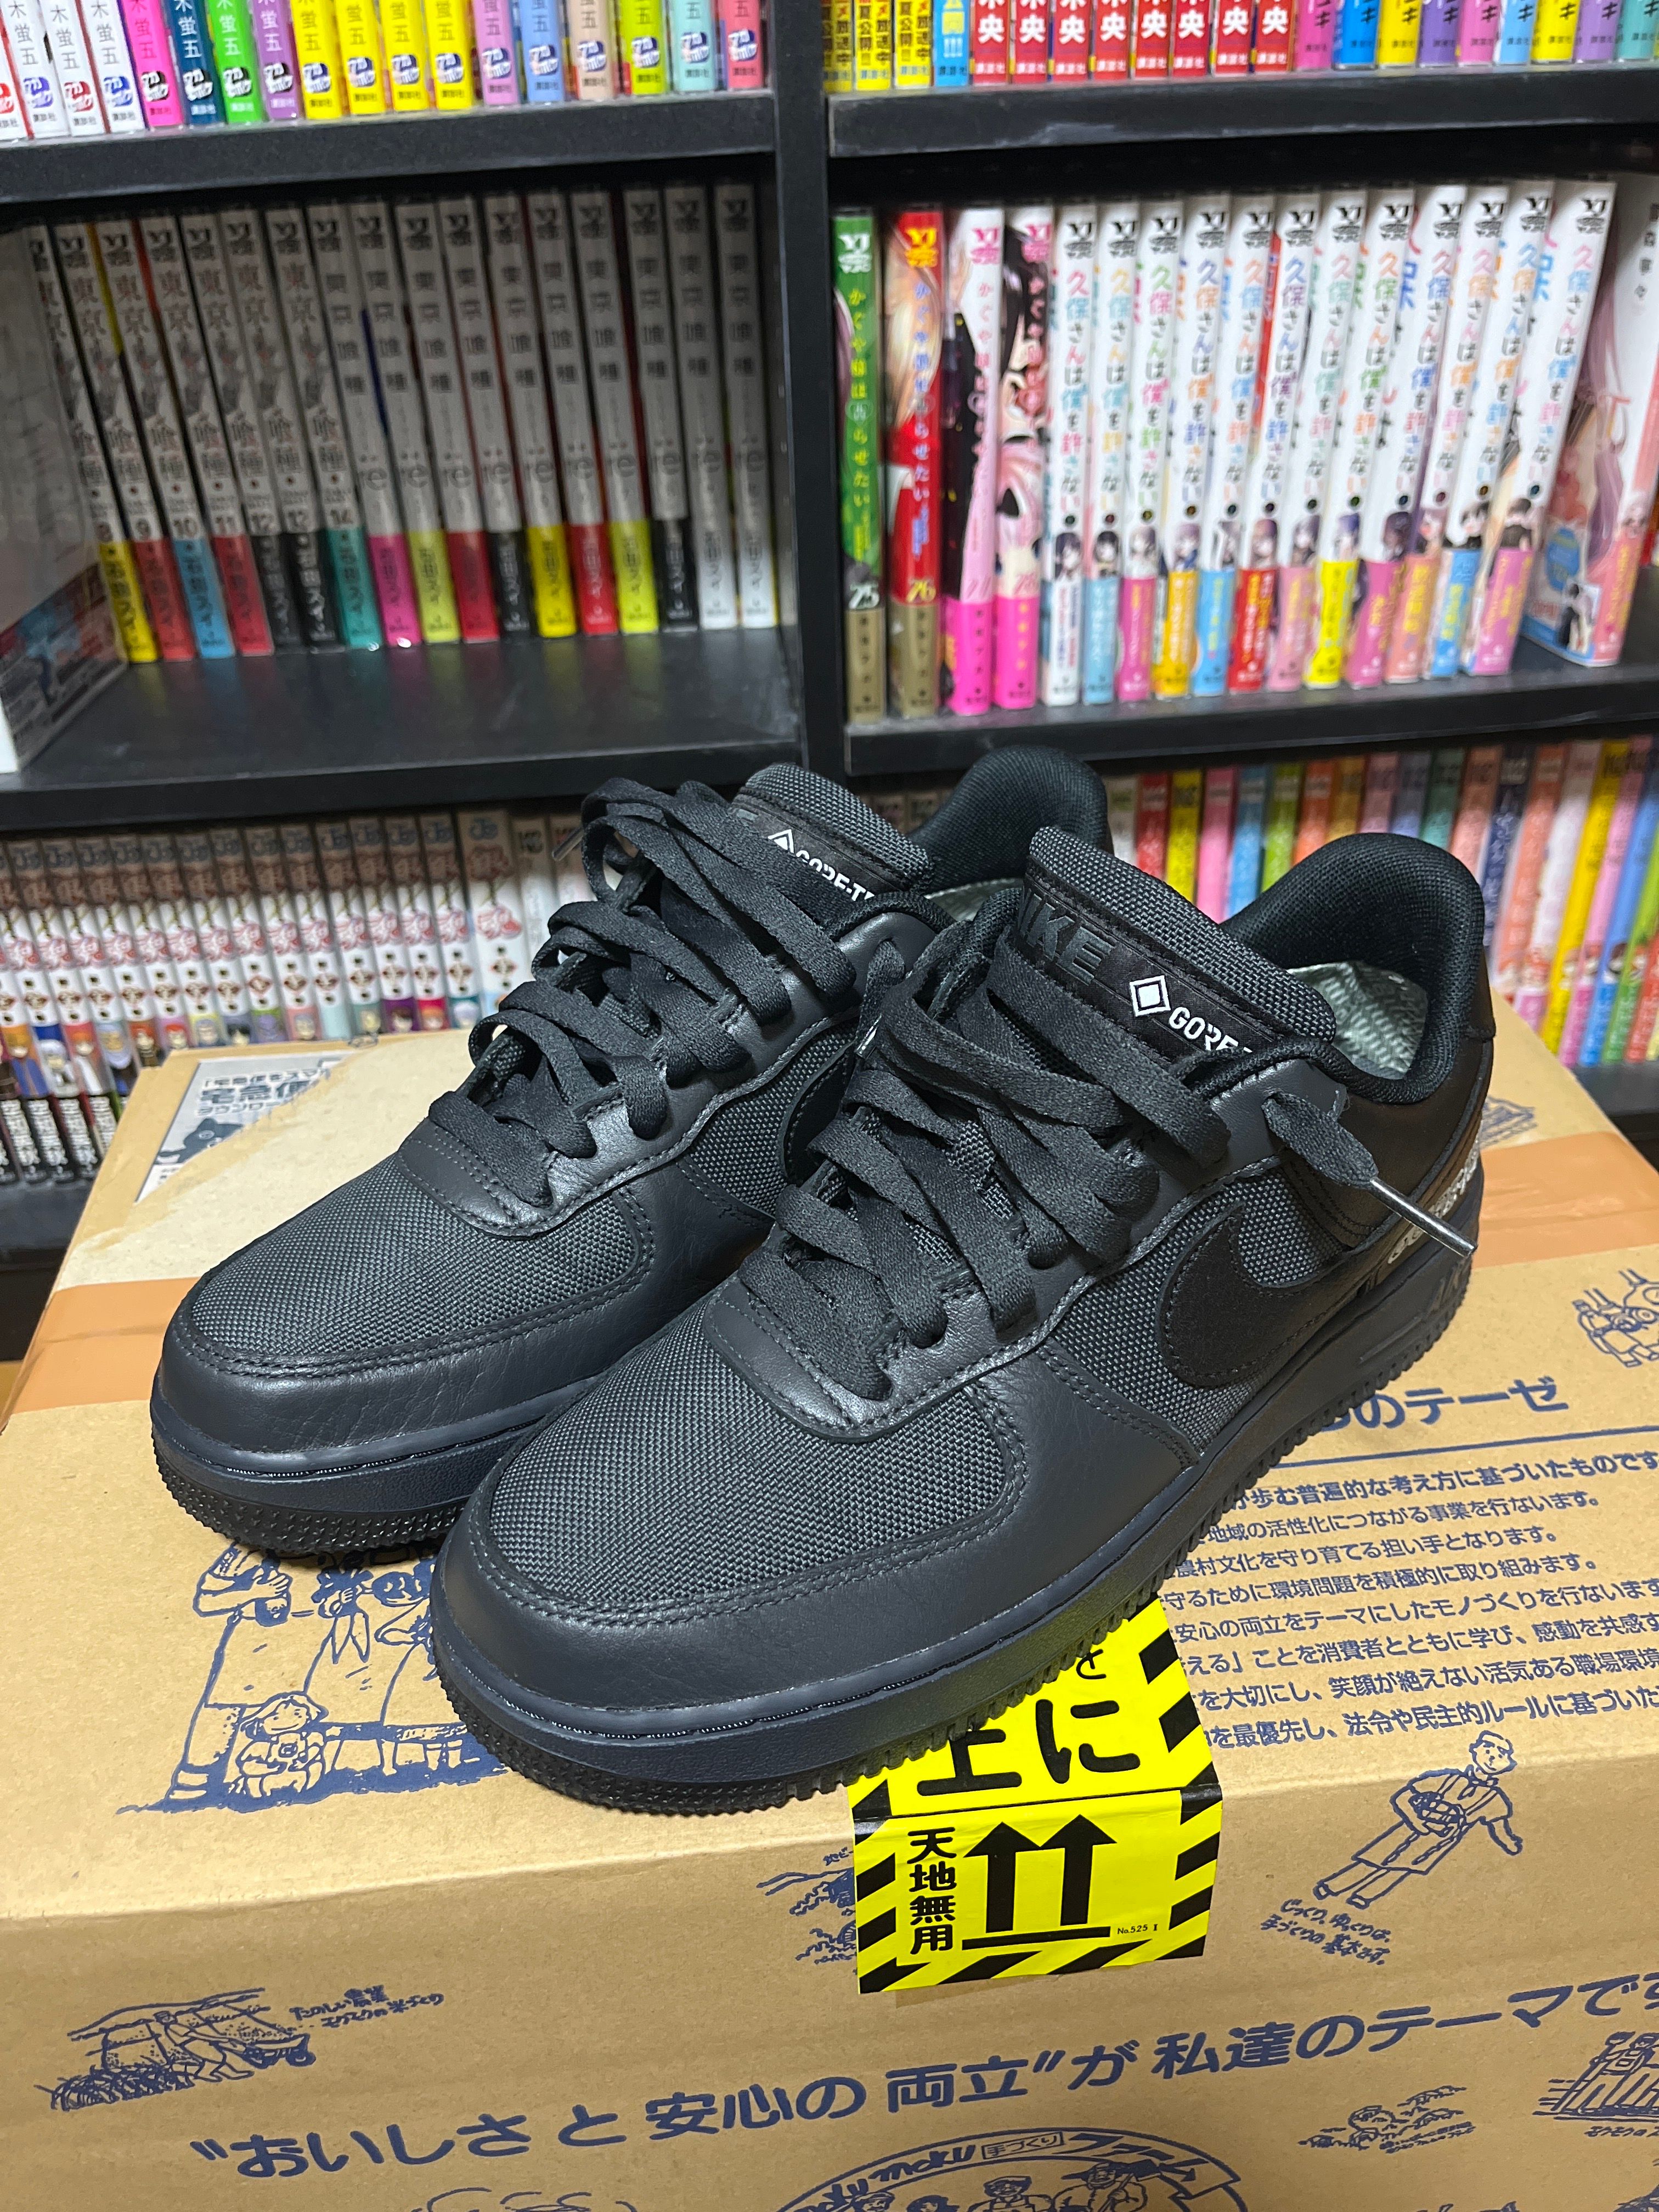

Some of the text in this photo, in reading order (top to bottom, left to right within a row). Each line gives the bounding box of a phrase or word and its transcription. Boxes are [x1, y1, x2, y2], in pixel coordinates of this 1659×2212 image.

[1319, 1375, 1569, 1432] のテーゼ
[1171, 1525, 1557, 1578] 農村文化を守り育てる担い手となります。
[1159, 1553, 1597, 1612] 守るために環境問題を積極的に取り組みます。
[907, 1826, 957, 1955] 天地無用
